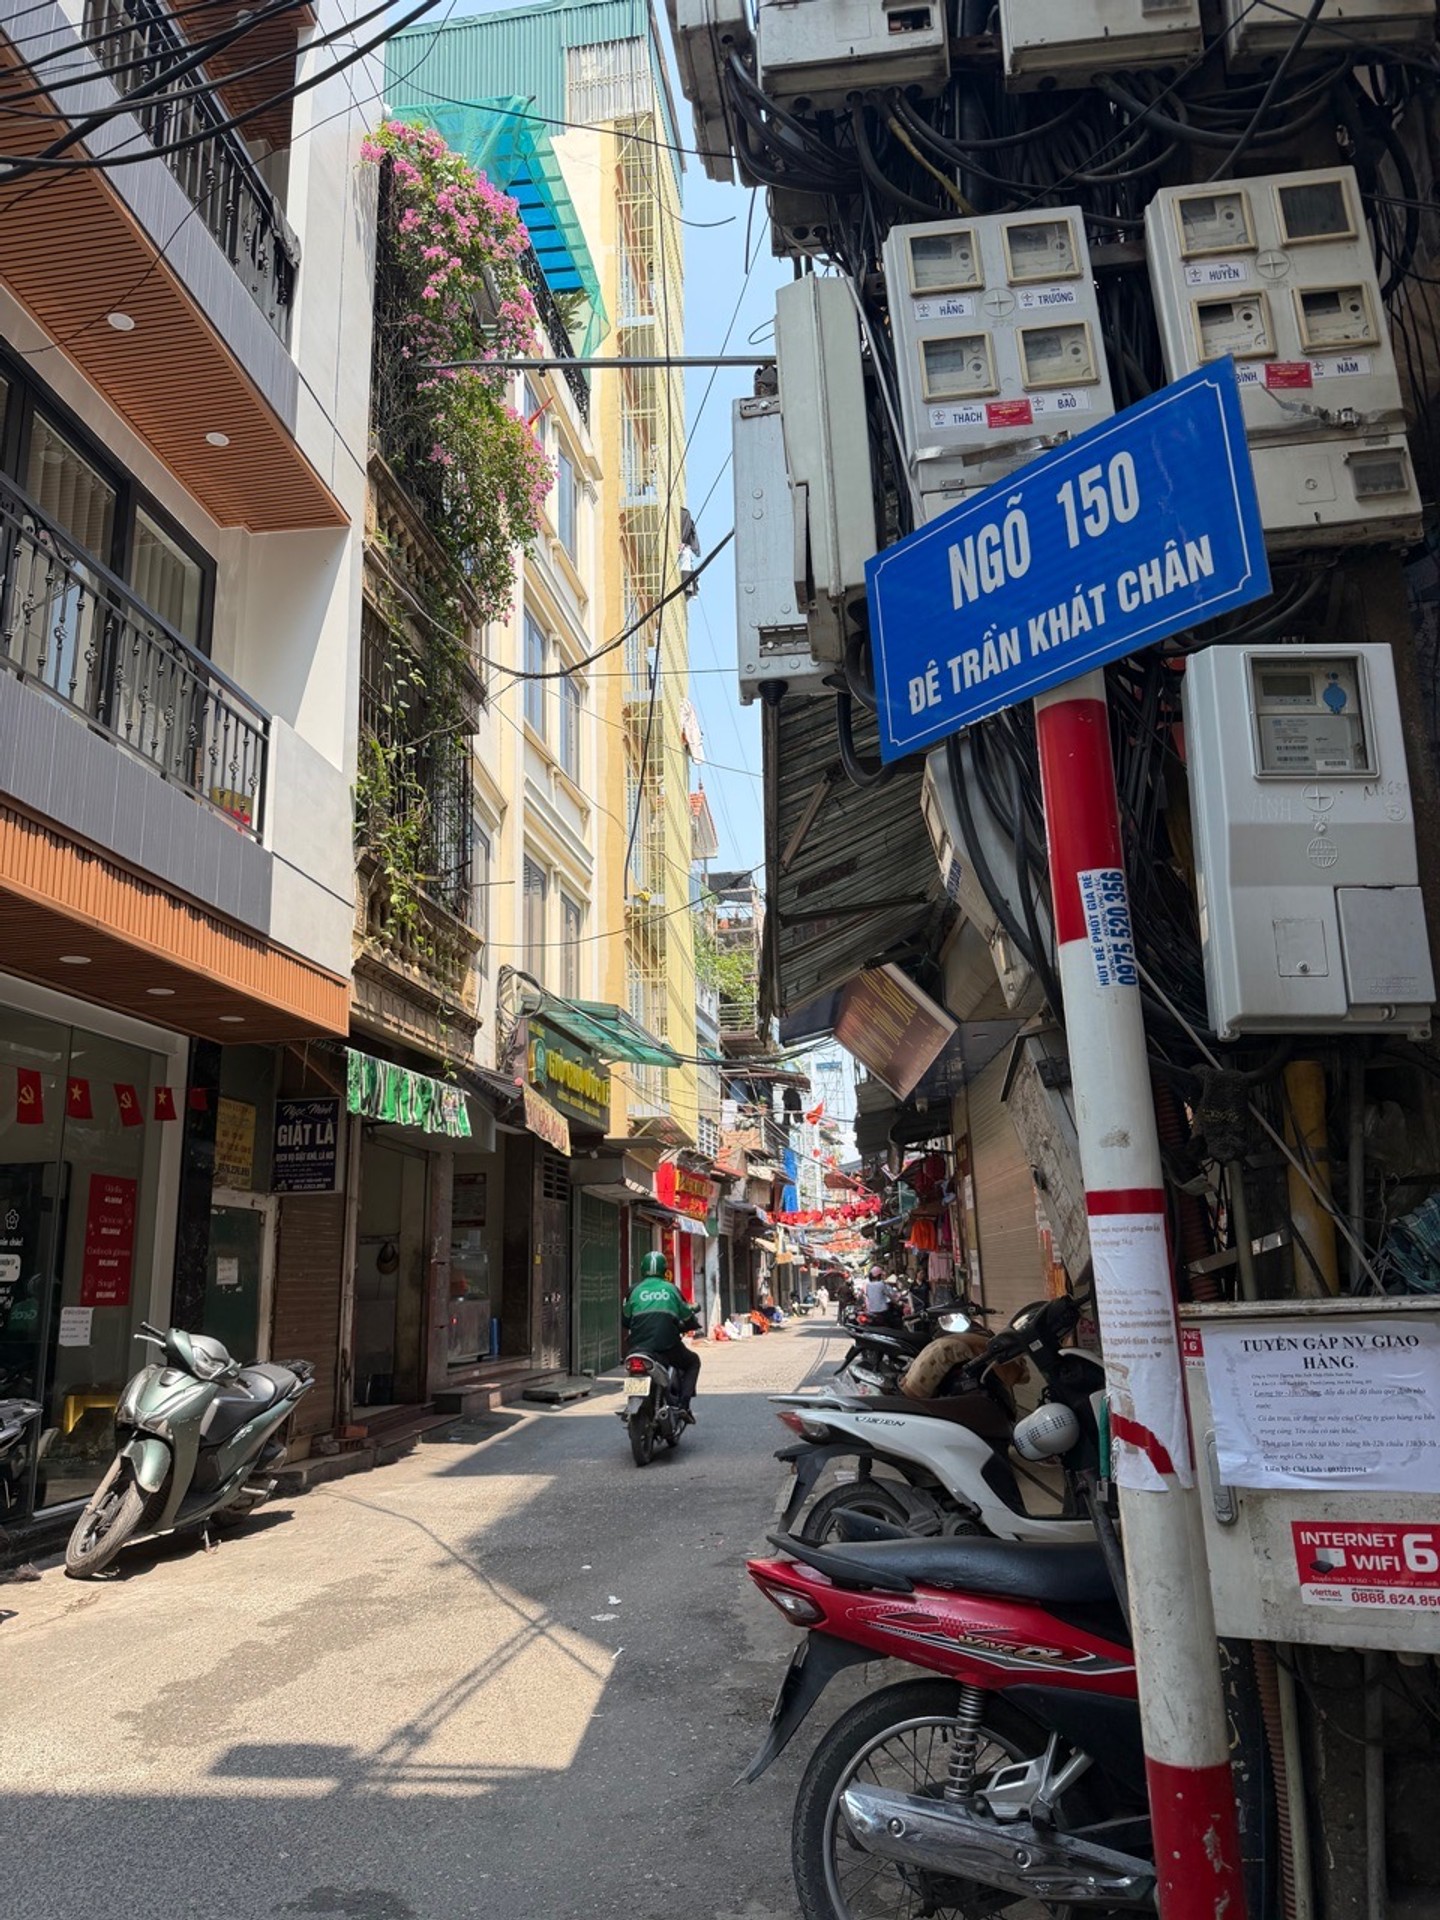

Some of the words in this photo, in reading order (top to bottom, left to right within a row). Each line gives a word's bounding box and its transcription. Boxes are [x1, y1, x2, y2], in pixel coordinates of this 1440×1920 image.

[948, 493, 1032, 610] NGÕ
[1057, 450, 1140, 549] 150
[908, 660, 941, 715] ĐÊ
[948, 623, 1020, 694] TRẦN
[1029, 583, 1106, 657] KHÁT
[1117, 534, 1214, 612] CHÂN
[1079, 874, 1093, 889] RẺ
[1083, 891, 1097, 910] GIÁ
[1088, 915, 1102, 943] PHỐT
[1091, 945, 1106, 964] BỂ
[1097, 965, 1110, 986] HÚT
[277, 1119, 312, 1151] GIẶT
[315, 1118, 335, 1145] LÀ
[639, 1289, 670, 1301] Grab
[1303, 1333, 1338, 1350] GẤP
[1342, 1335, 1367, 1348] NV
[1371, 1335, 1419, 1348] GIAO
[1300, 1531, 1397, 1547] INTERNET
[1351, 1554, 1400, 1571] WIFI
[1402, 1533, 1439, 1573] 6
